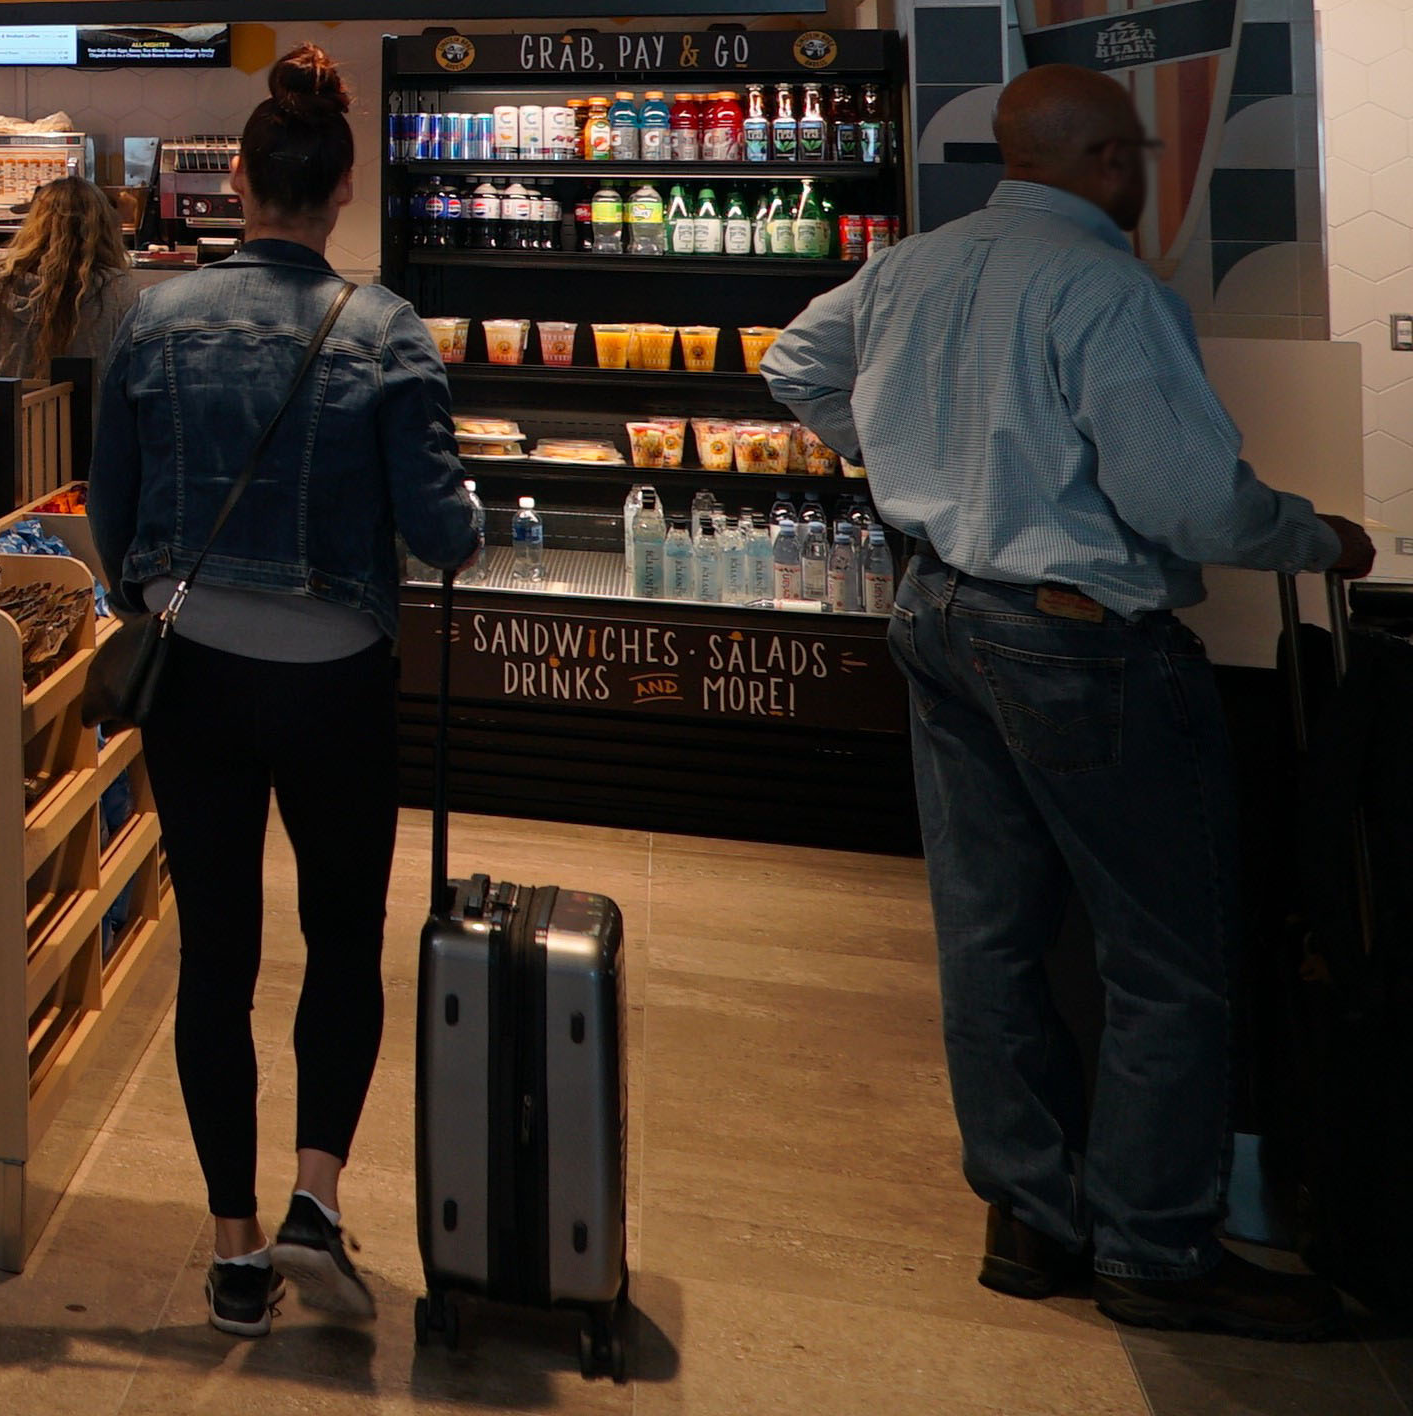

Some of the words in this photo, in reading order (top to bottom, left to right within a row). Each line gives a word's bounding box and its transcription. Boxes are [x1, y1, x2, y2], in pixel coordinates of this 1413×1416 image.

[520, 34, 604, 72] GRAB,
[619, 34, 664, 70] PAY
[679, 34, 701, 68] &
[714, 34, 749, 68] GO
[1097, 28, 1157, 45] PIZZA
[780, 573, 790, 599] evian
[473, 615, 679, 667] SANDWICHES
[708, 632, 828, 678] SALADS
[504, 658, 610, 701] DRINKS
[636, 678, 678, 697] AND
[703, 676, 797, 718] MORE!
